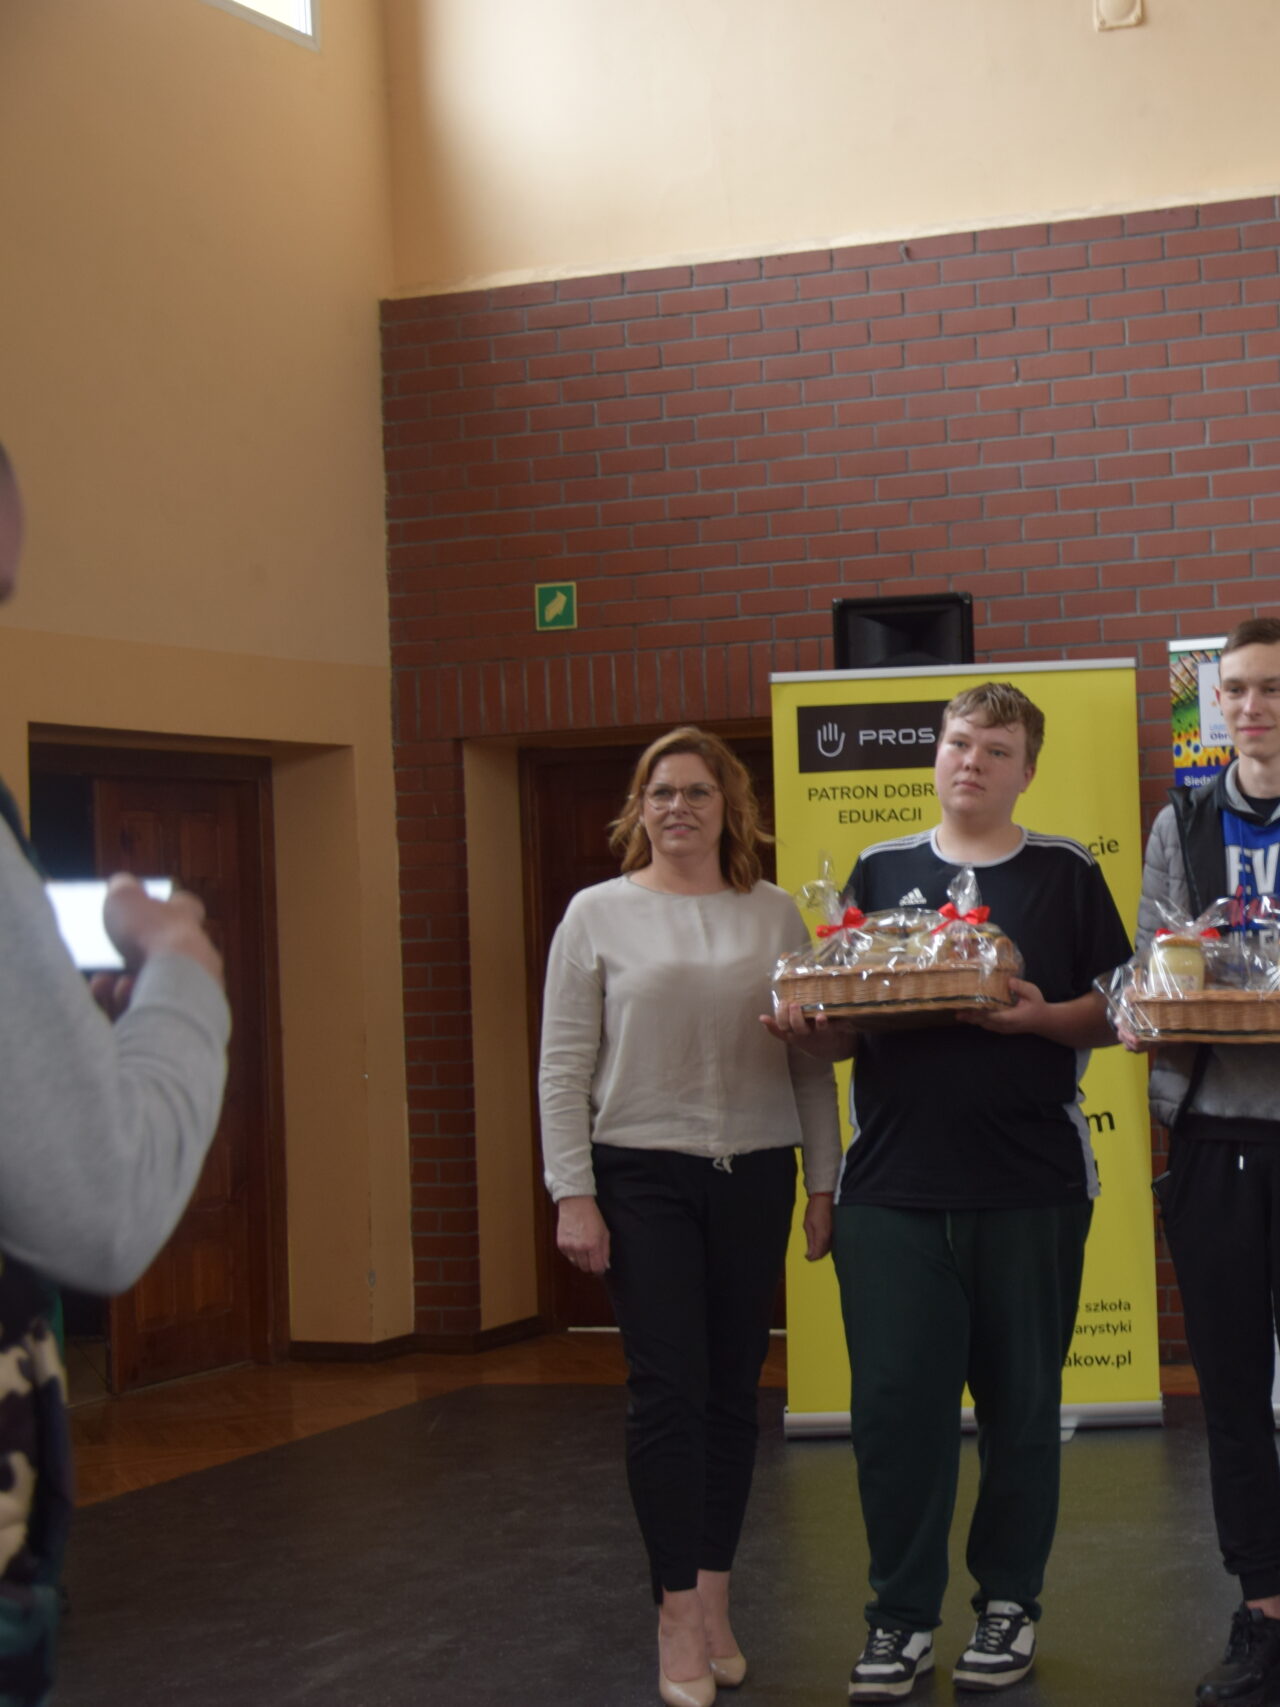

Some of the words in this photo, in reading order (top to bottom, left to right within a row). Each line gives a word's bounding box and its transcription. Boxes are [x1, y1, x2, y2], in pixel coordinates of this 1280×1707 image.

[858, 727, 936, 747] PROS
[808, 784, 879, 802] PATRON
[884, 782, 937, 799] DOBR
[838, 807, 922, 824] EDUKACJI
[1088, 835, 1120, 857] cie
[1085, 1299, 1131, 1312] szkoła
[1074, 1320, 1132, 1337] arystyki
[1064, 1350, 1132, 1370] akow.pl
